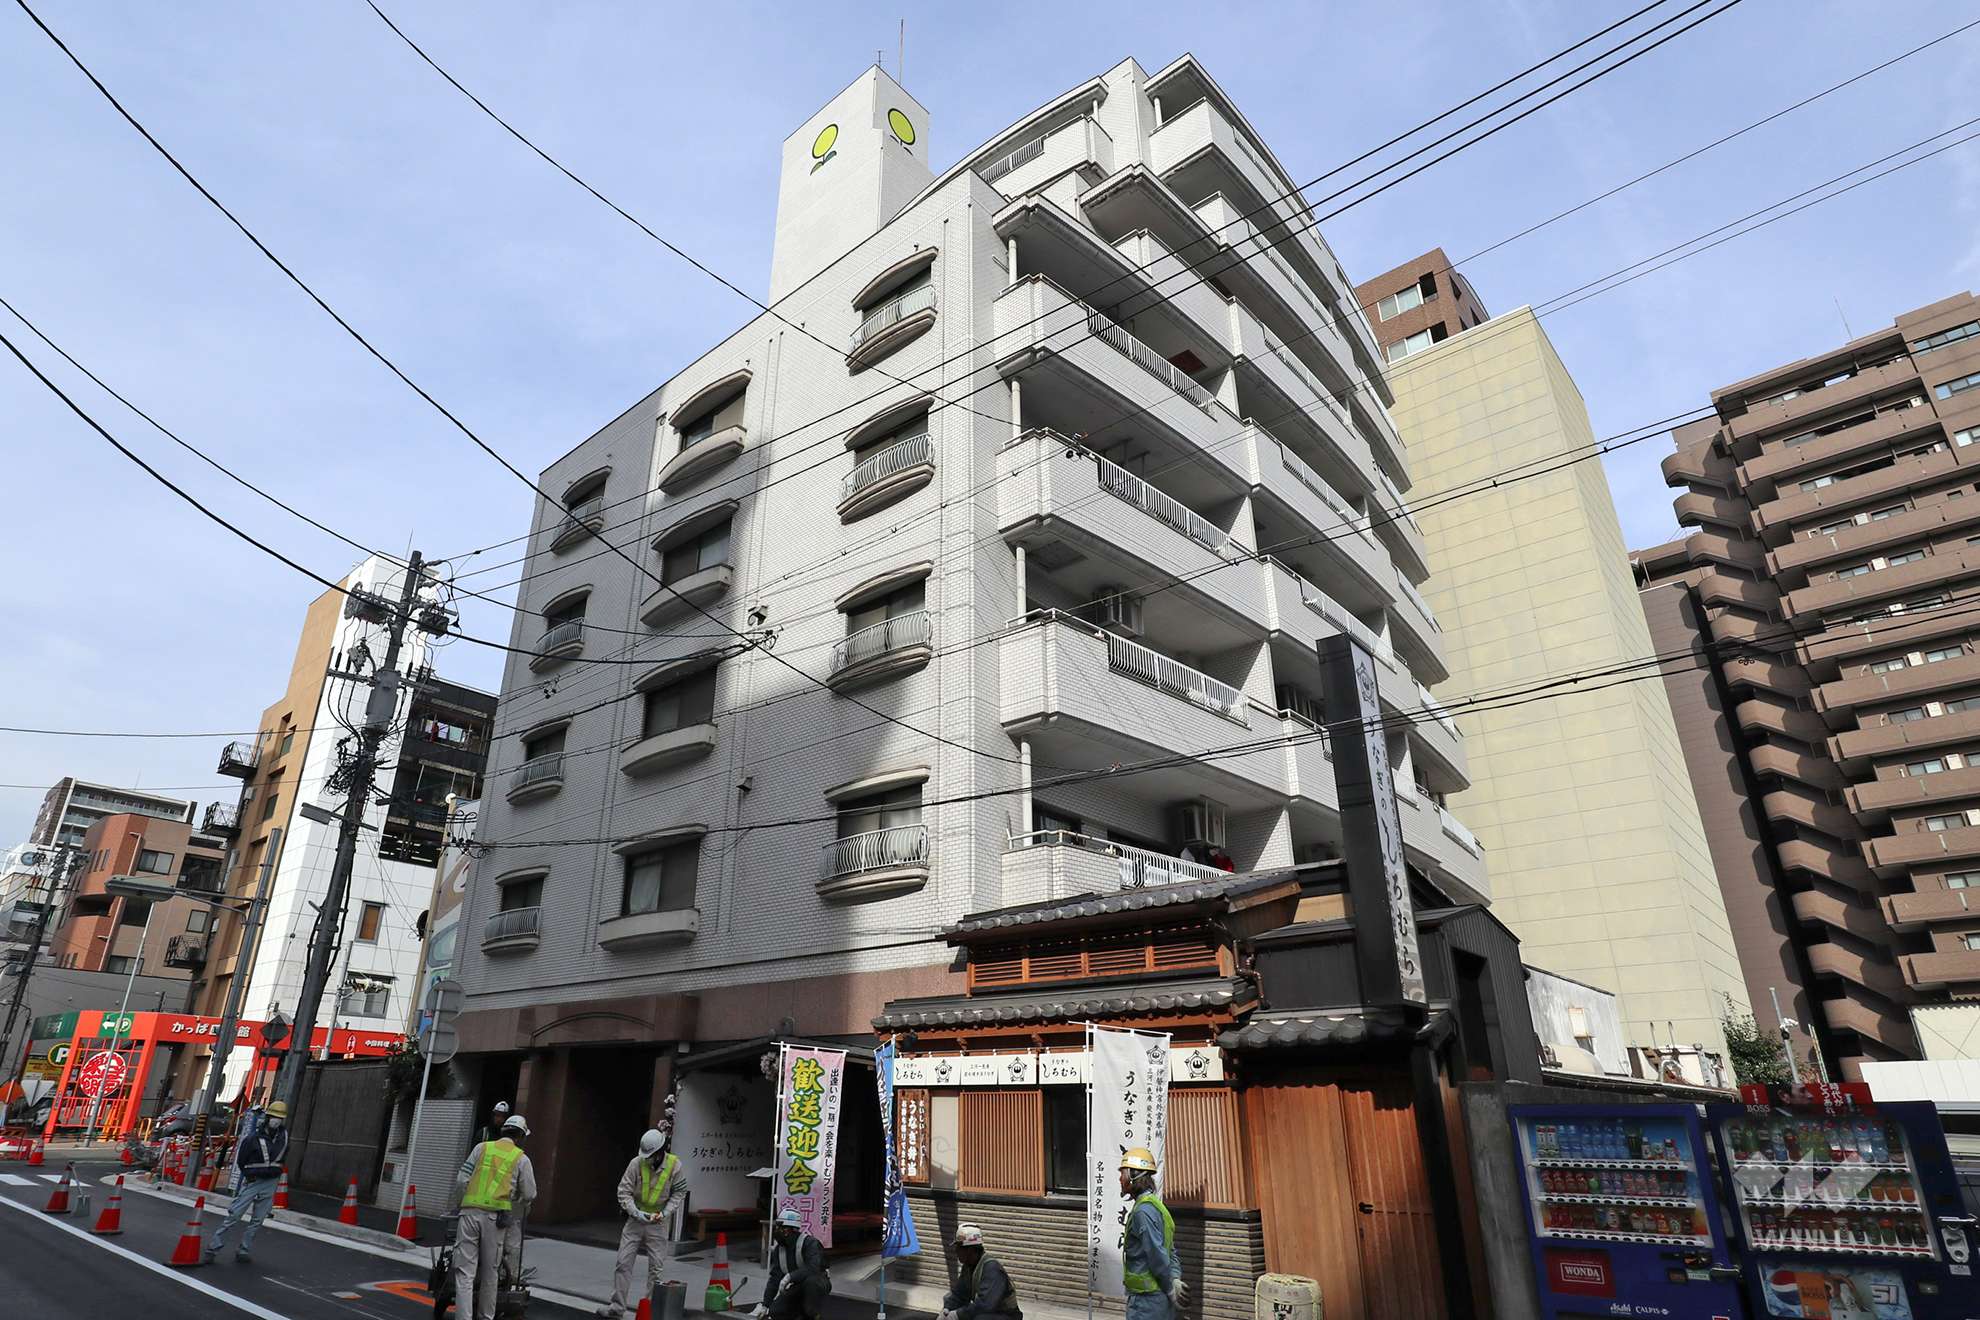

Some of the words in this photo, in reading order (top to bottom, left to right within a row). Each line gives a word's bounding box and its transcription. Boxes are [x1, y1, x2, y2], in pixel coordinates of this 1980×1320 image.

[171, 1021, 250, 1037] かっぱ館
[895, 1066, 924, 1081] しろむら
[1042, 1063, 1077, 1078] しろむら
[1746, 1104, 1771, 1113] BOSS
[784, 1056, 825, 1196] 歓送迎会
[907, 1099, 918, 1177] うなぎ弁当
[1089, 1160, 1106, 1282] 名古屋名物ひつまぶし
[1564, 1265, 1601, 1278] WONDA
